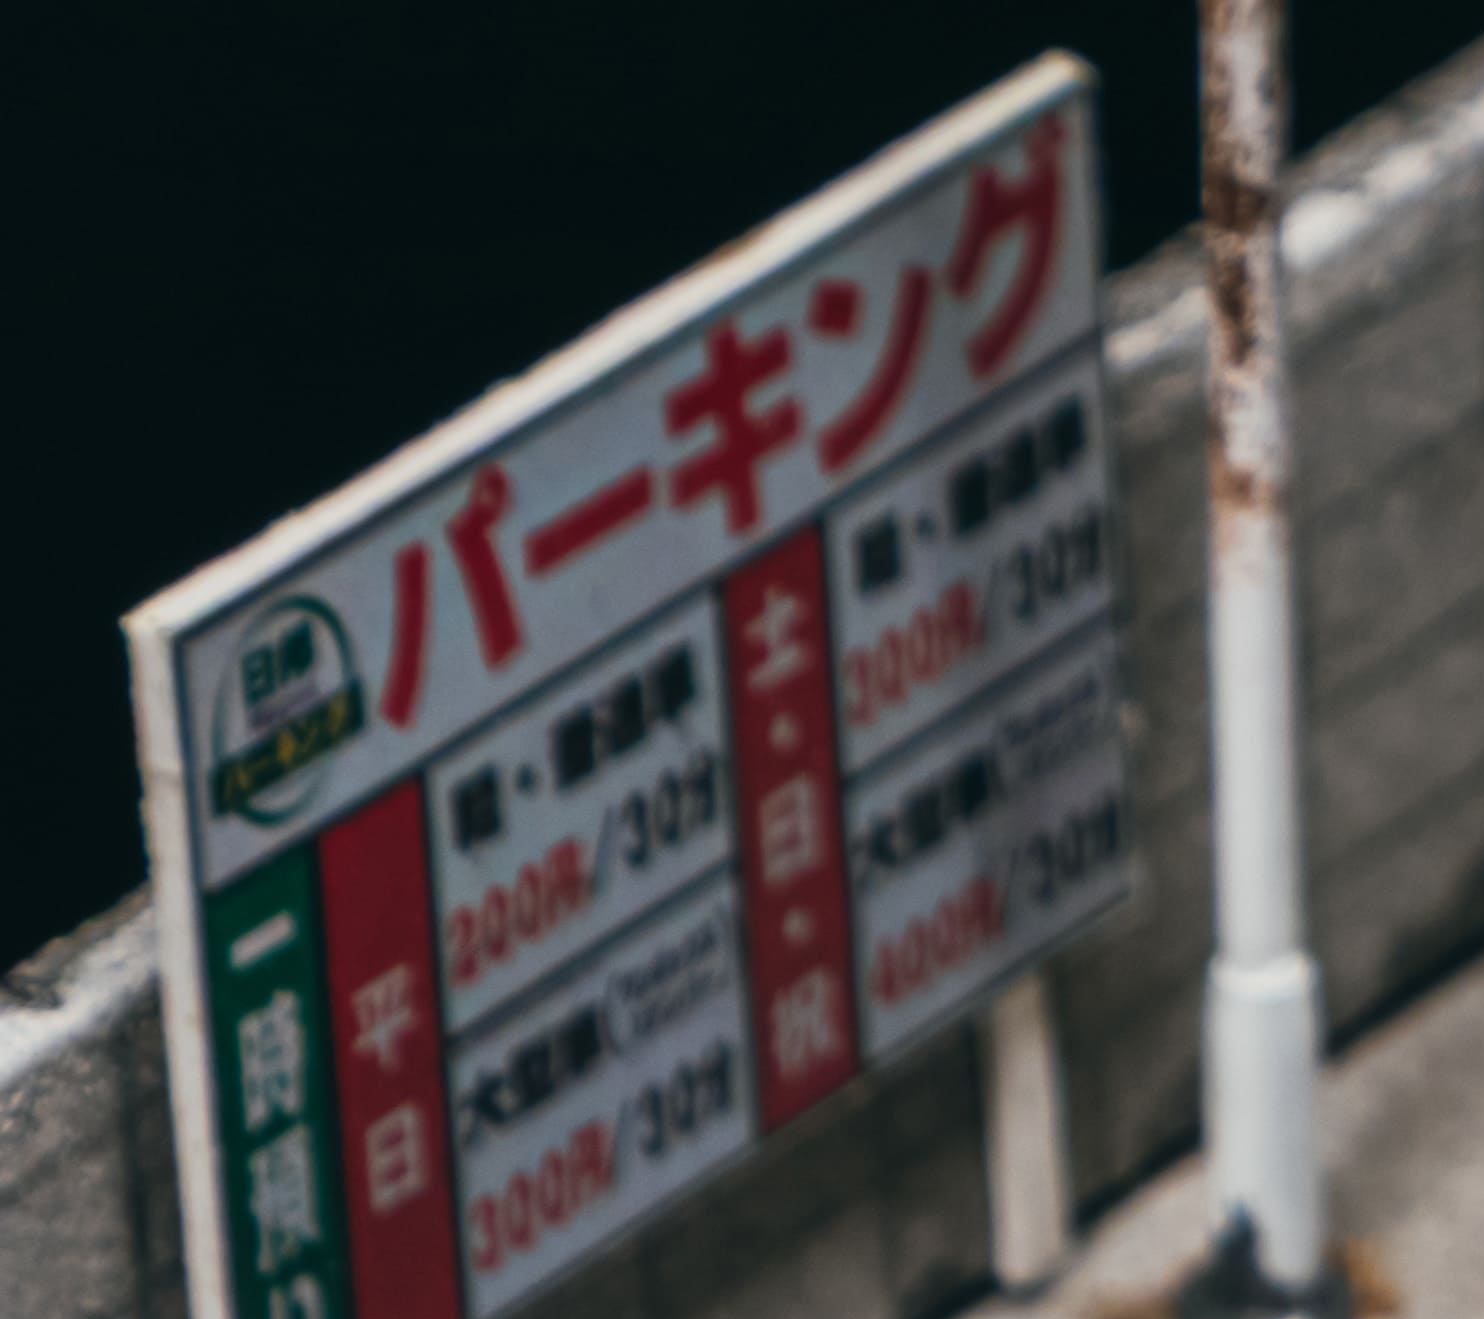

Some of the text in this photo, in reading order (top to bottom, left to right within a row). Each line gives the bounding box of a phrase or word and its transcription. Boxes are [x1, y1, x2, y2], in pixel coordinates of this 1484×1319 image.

[380, 112, 1068, 730] パーキング
[350, 962, 430, 1214] 平日
